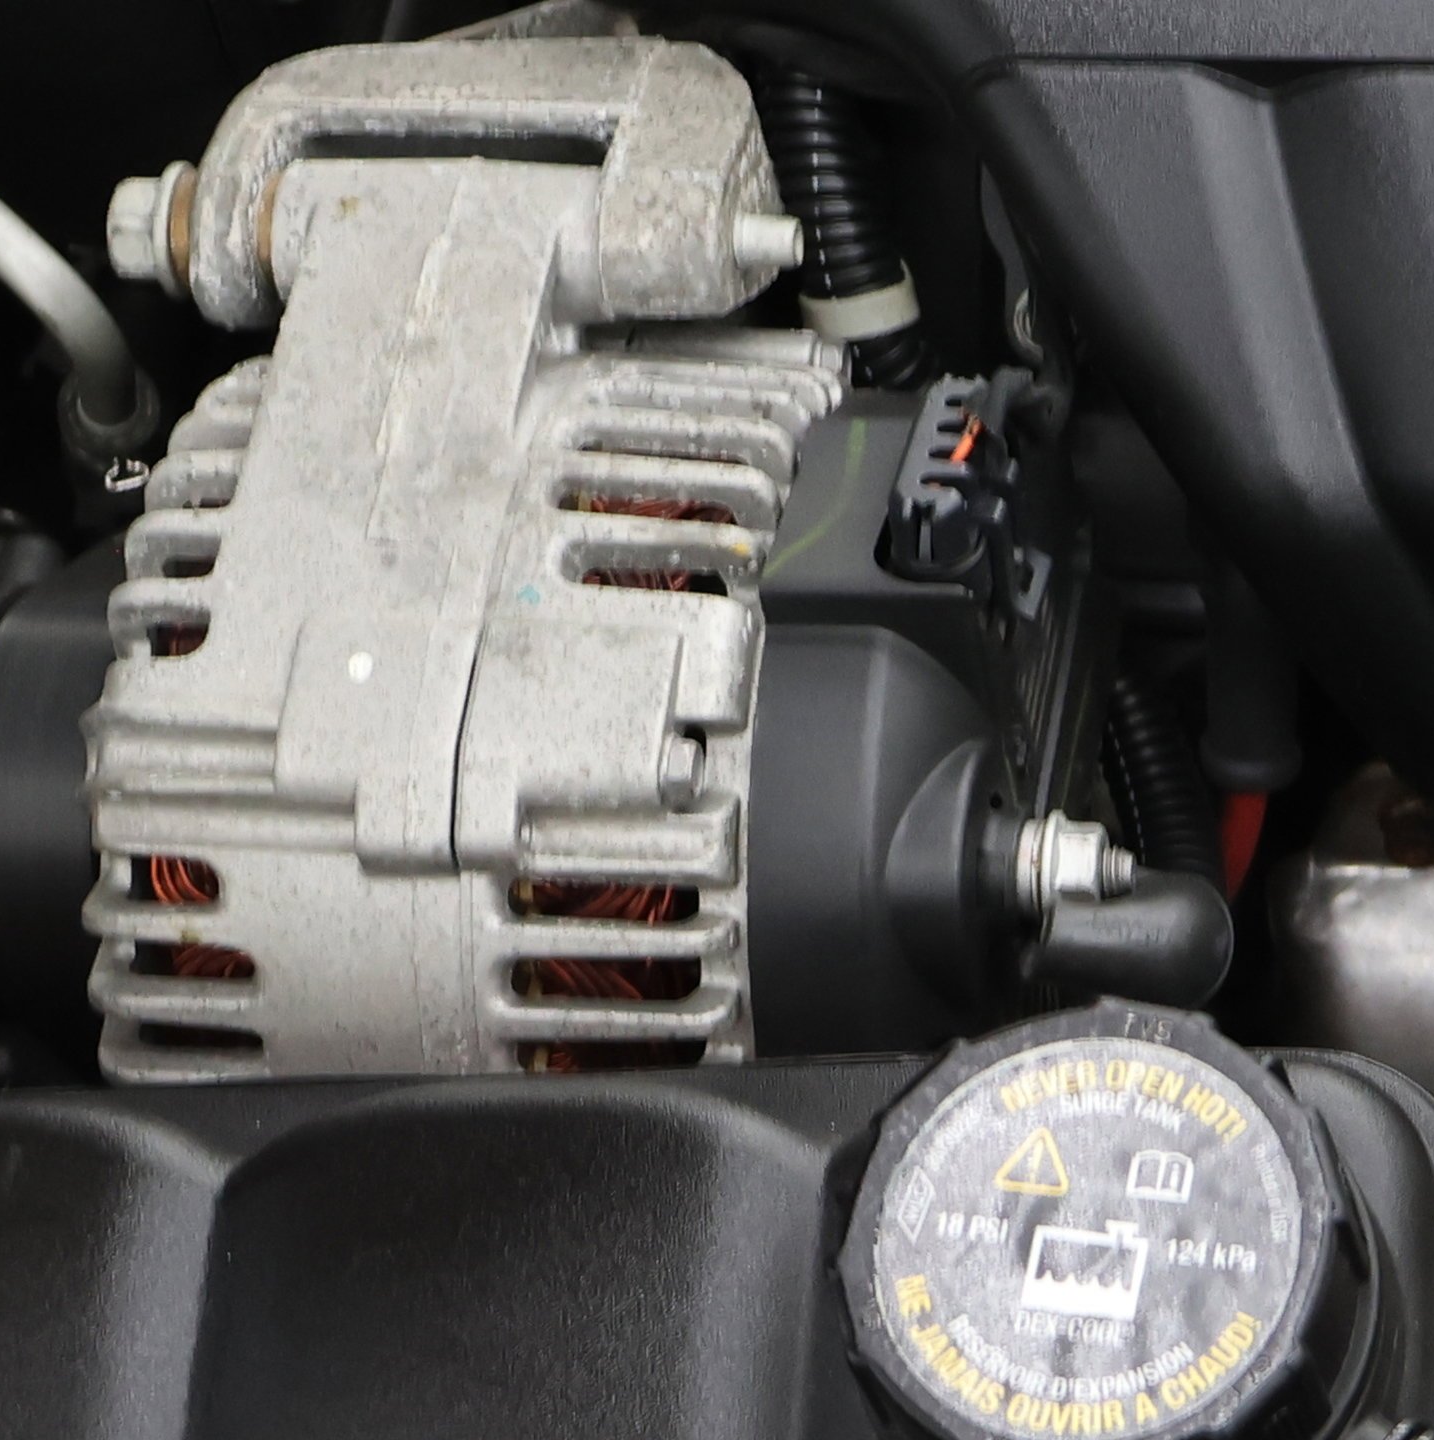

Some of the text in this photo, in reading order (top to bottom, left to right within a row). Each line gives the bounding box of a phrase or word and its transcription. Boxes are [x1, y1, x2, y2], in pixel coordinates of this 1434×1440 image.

[1000, 1058, 1248, 1146] NEVER OPEN HOT!
[1060, 1089, 1186, 1136] SURGE TANK
[936, 1210, 1009, 1245] 18 PSI
[1166, 1236, 1257, 1273] 124 kPa
[894, 1273, 932, 1318] NE
[909, 1322, 1006, 1416] JAMAIS
[1160, 1310, 1263, 1410] CHAUD!
[1006, 1392, 1126, 1437] OUVRIR
